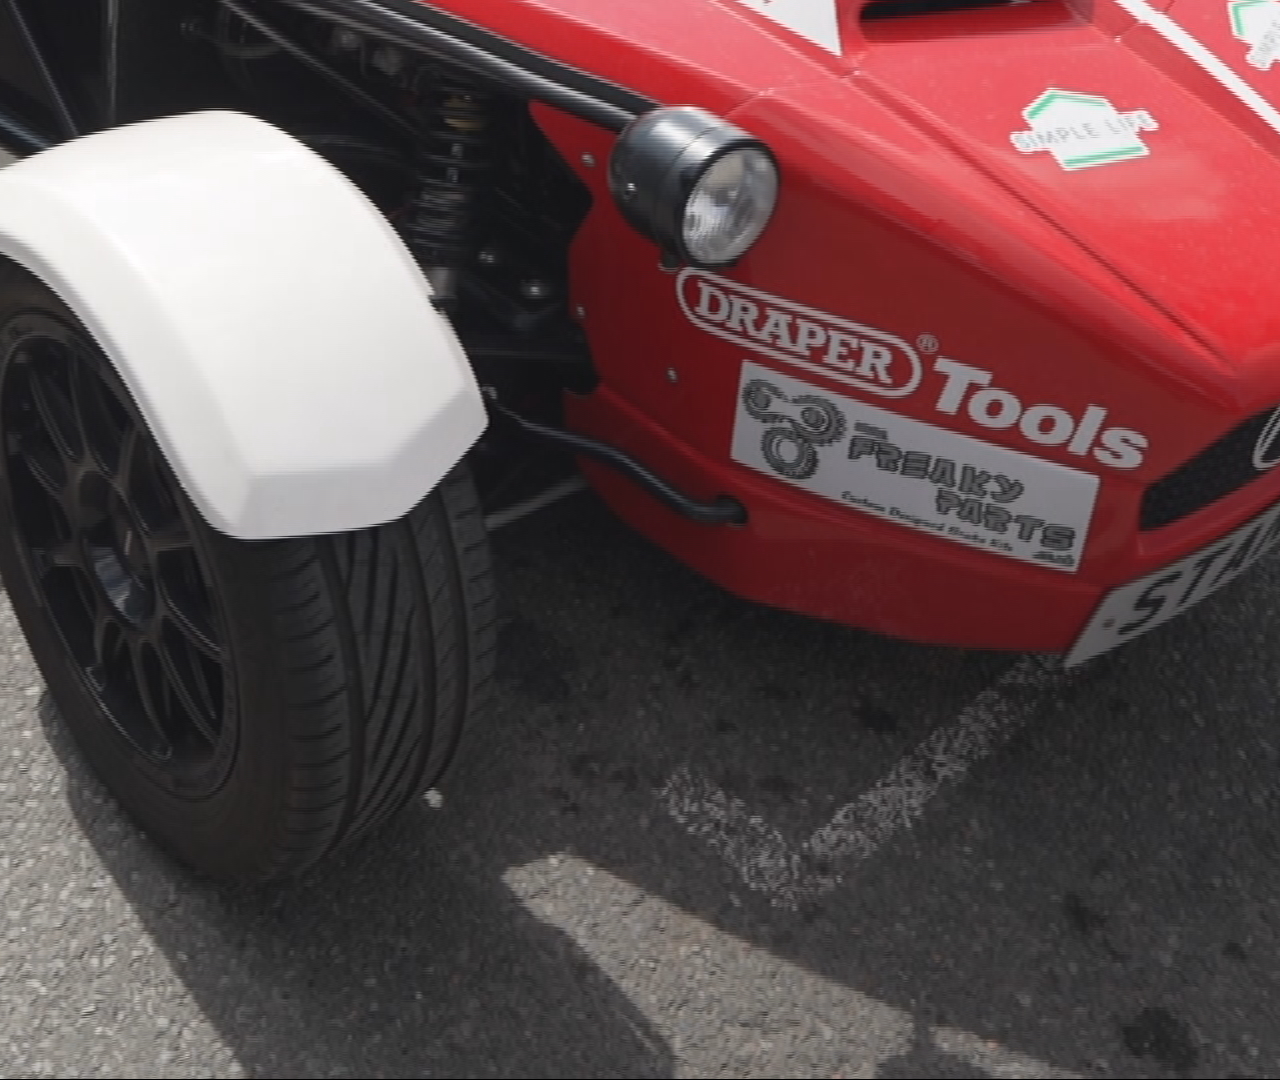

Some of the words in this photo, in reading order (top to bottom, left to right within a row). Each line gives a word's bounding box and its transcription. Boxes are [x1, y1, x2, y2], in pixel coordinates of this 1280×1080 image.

[1013, 123, 1102, 150] SIMPLE
[1103, 113, 1152, 136] LIFE
[694, 279, 893, 385] DRAPER
[933, 356, 1149, 469] Tools
[847, 435, 1025, 503] FREAKY
[934, 488, 1077, 551] PARTS
